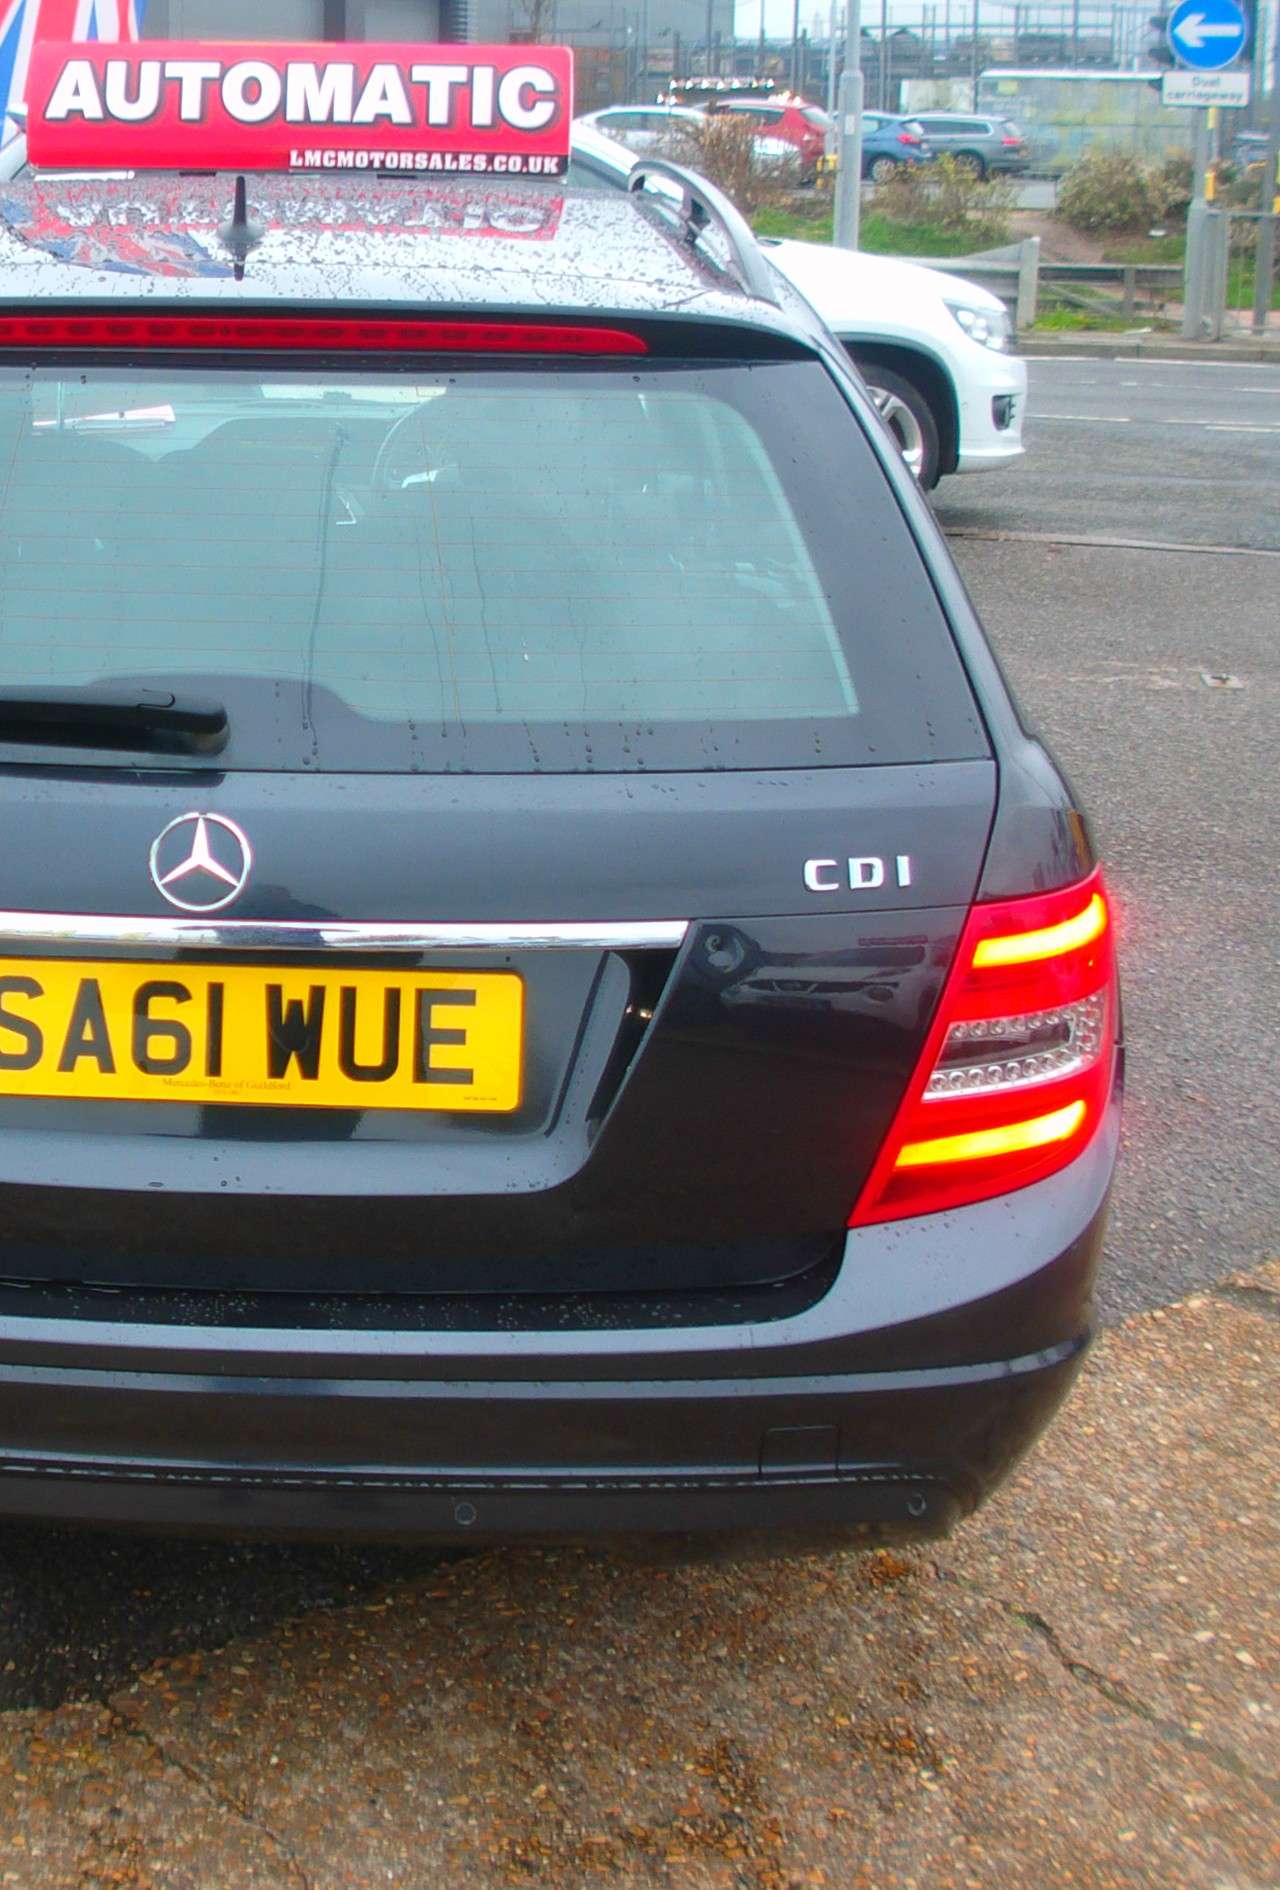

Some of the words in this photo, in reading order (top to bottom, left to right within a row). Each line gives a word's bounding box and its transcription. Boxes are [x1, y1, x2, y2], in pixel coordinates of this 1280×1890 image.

[43, 59, 558, 132] AUTOMATIC
[288, 149, 560, 174] LMCMOTORSALES.CO.UK
[803, 855, 912, 892] CDI
[264, 983, 478, 1085] WUE
